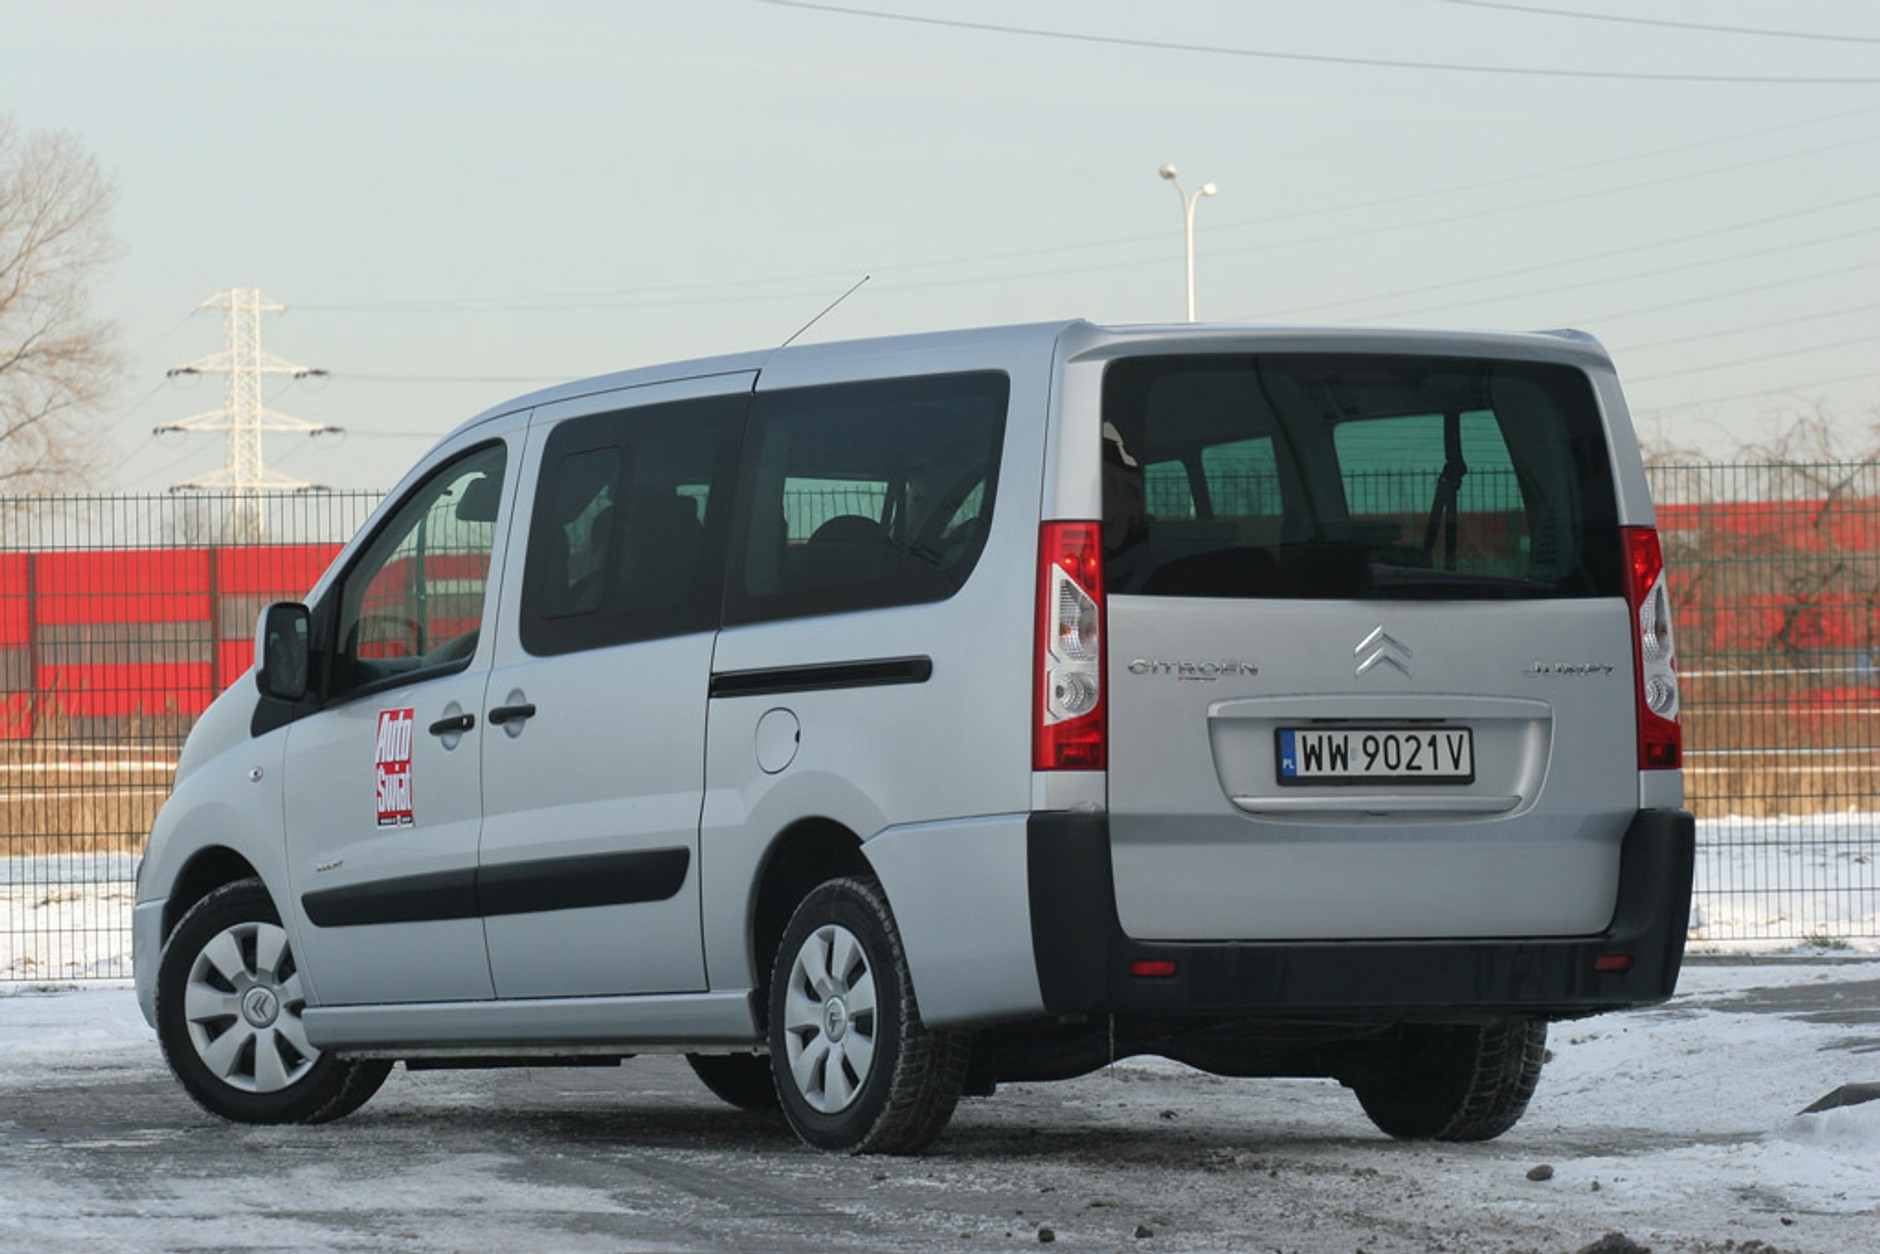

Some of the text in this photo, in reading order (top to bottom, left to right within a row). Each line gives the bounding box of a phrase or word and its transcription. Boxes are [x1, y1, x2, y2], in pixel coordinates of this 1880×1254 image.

[376, 710, 413, 762] Auto
[1302, 734, 1464, 771] WW 9021V
[1282, 758, 1295, 769] PL
